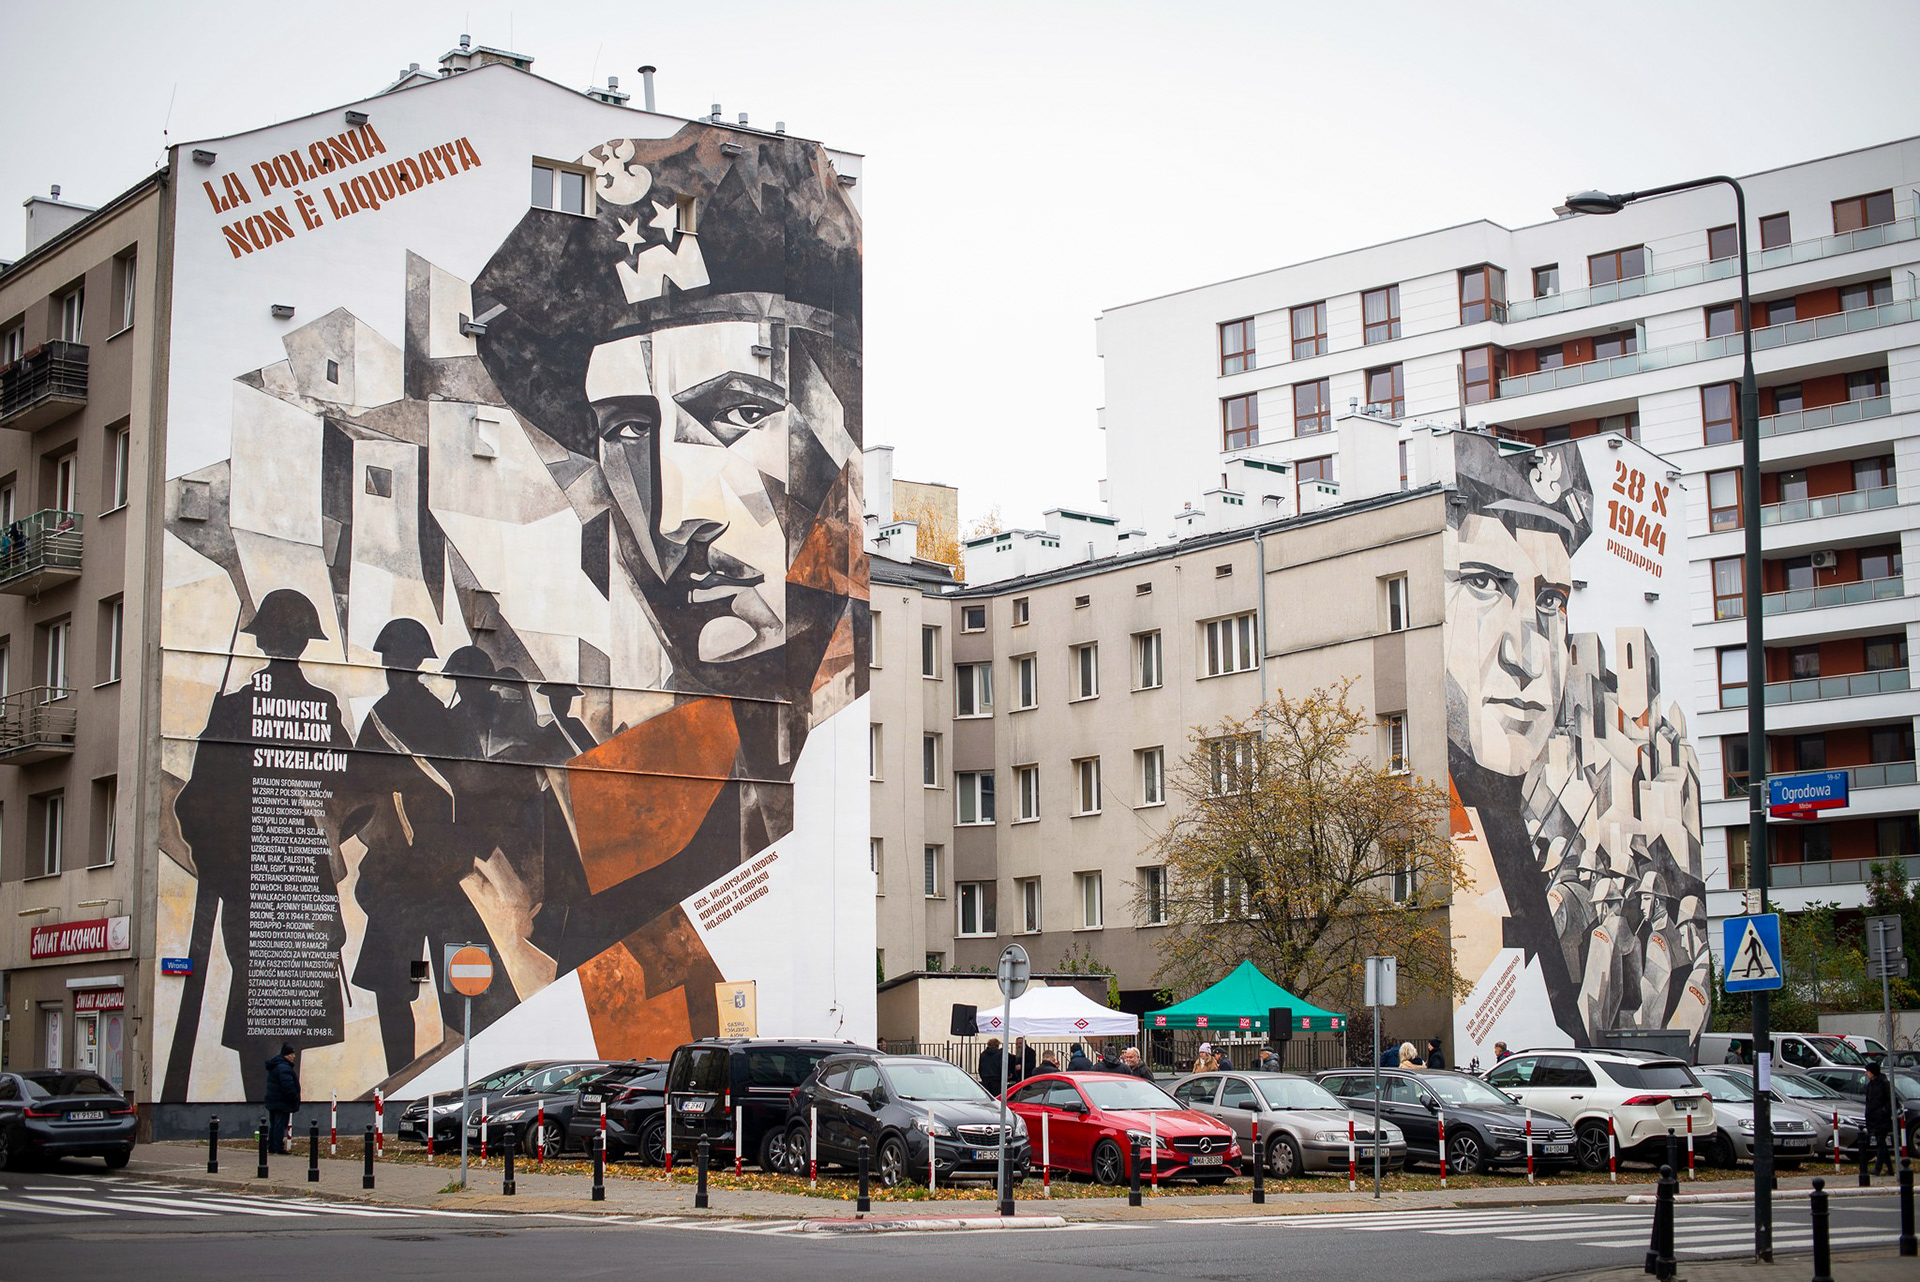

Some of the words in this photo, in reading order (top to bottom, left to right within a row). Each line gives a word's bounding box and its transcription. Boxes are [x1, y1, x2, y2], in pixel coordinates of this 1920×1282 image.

[202, 172, 251, 214] LA
[251, 123, 387, 197] POLONIA
[221, 205, 295, 259] NON
[294, 189, 324, 231] È
[323, 136, 482, 220] LIQUIDATA
[1612, 460, 1645, 503] 28
[1652, 481, 1669, 517] X
[1608, 501, 1666, 556] 1944
[1607, 538, 1662, 578] PREDAPPIO
[253, 673, 272, 692] 18
[252, 697, 328, 720] LWOWSKI
[252, 719, 331, 742] BATALION
[253, 748, 348, 772] STRZELCÓW
[253, 778, 279, 786] BATALION
[281, 779, 321, 788] SFORMOWANY
[252, 797, 290, 806] WOJENNYCH.
[280, 789, 308, 797] POLSKICH
[309, 789, 333, 798] JEŃCÓW
[1782, 784, 1831, 803] Ogrodowa
[276, 808, 325, 817] SIKORSKI-MAJSKI
[251, 846, 287, 854] UZBEKISTAN,
[251, 854, 266, 863] IRAN,
[251, 874, 319, 883] PRZETRANSPORTOWANY
[694, 896, 710, 910] GEN.
[710, 868, 752, 900] WŁADYSŁAW
[752, 851, 779, 873] ANDERS
[699, 894, 733, 920] DOWÓDCA
[732, 891, 739, 900] 2
[738, 871, 770, 895] KORPUSU
[704, 909, 733, 931] WOJSKA
[732, 885, 769, 914] POLSKIEGO
[250, 921, 281, 929] PREDAPPIO
[32, 928, 59, 955] ŚWIAT
[60, 926, 105, 951] ALKOHOLI
[249, 950, 292, 959] WDZIĘCZNOŚCI
[267, 959, 300, 968] FASZYSTÓW
[77, 992, 95, 1008] ŚWIAT
[257, 988, 297, 996] ZAKOŃCZENIU
[248, 1007, 287, 1016] PÓŁNOCNYCH
